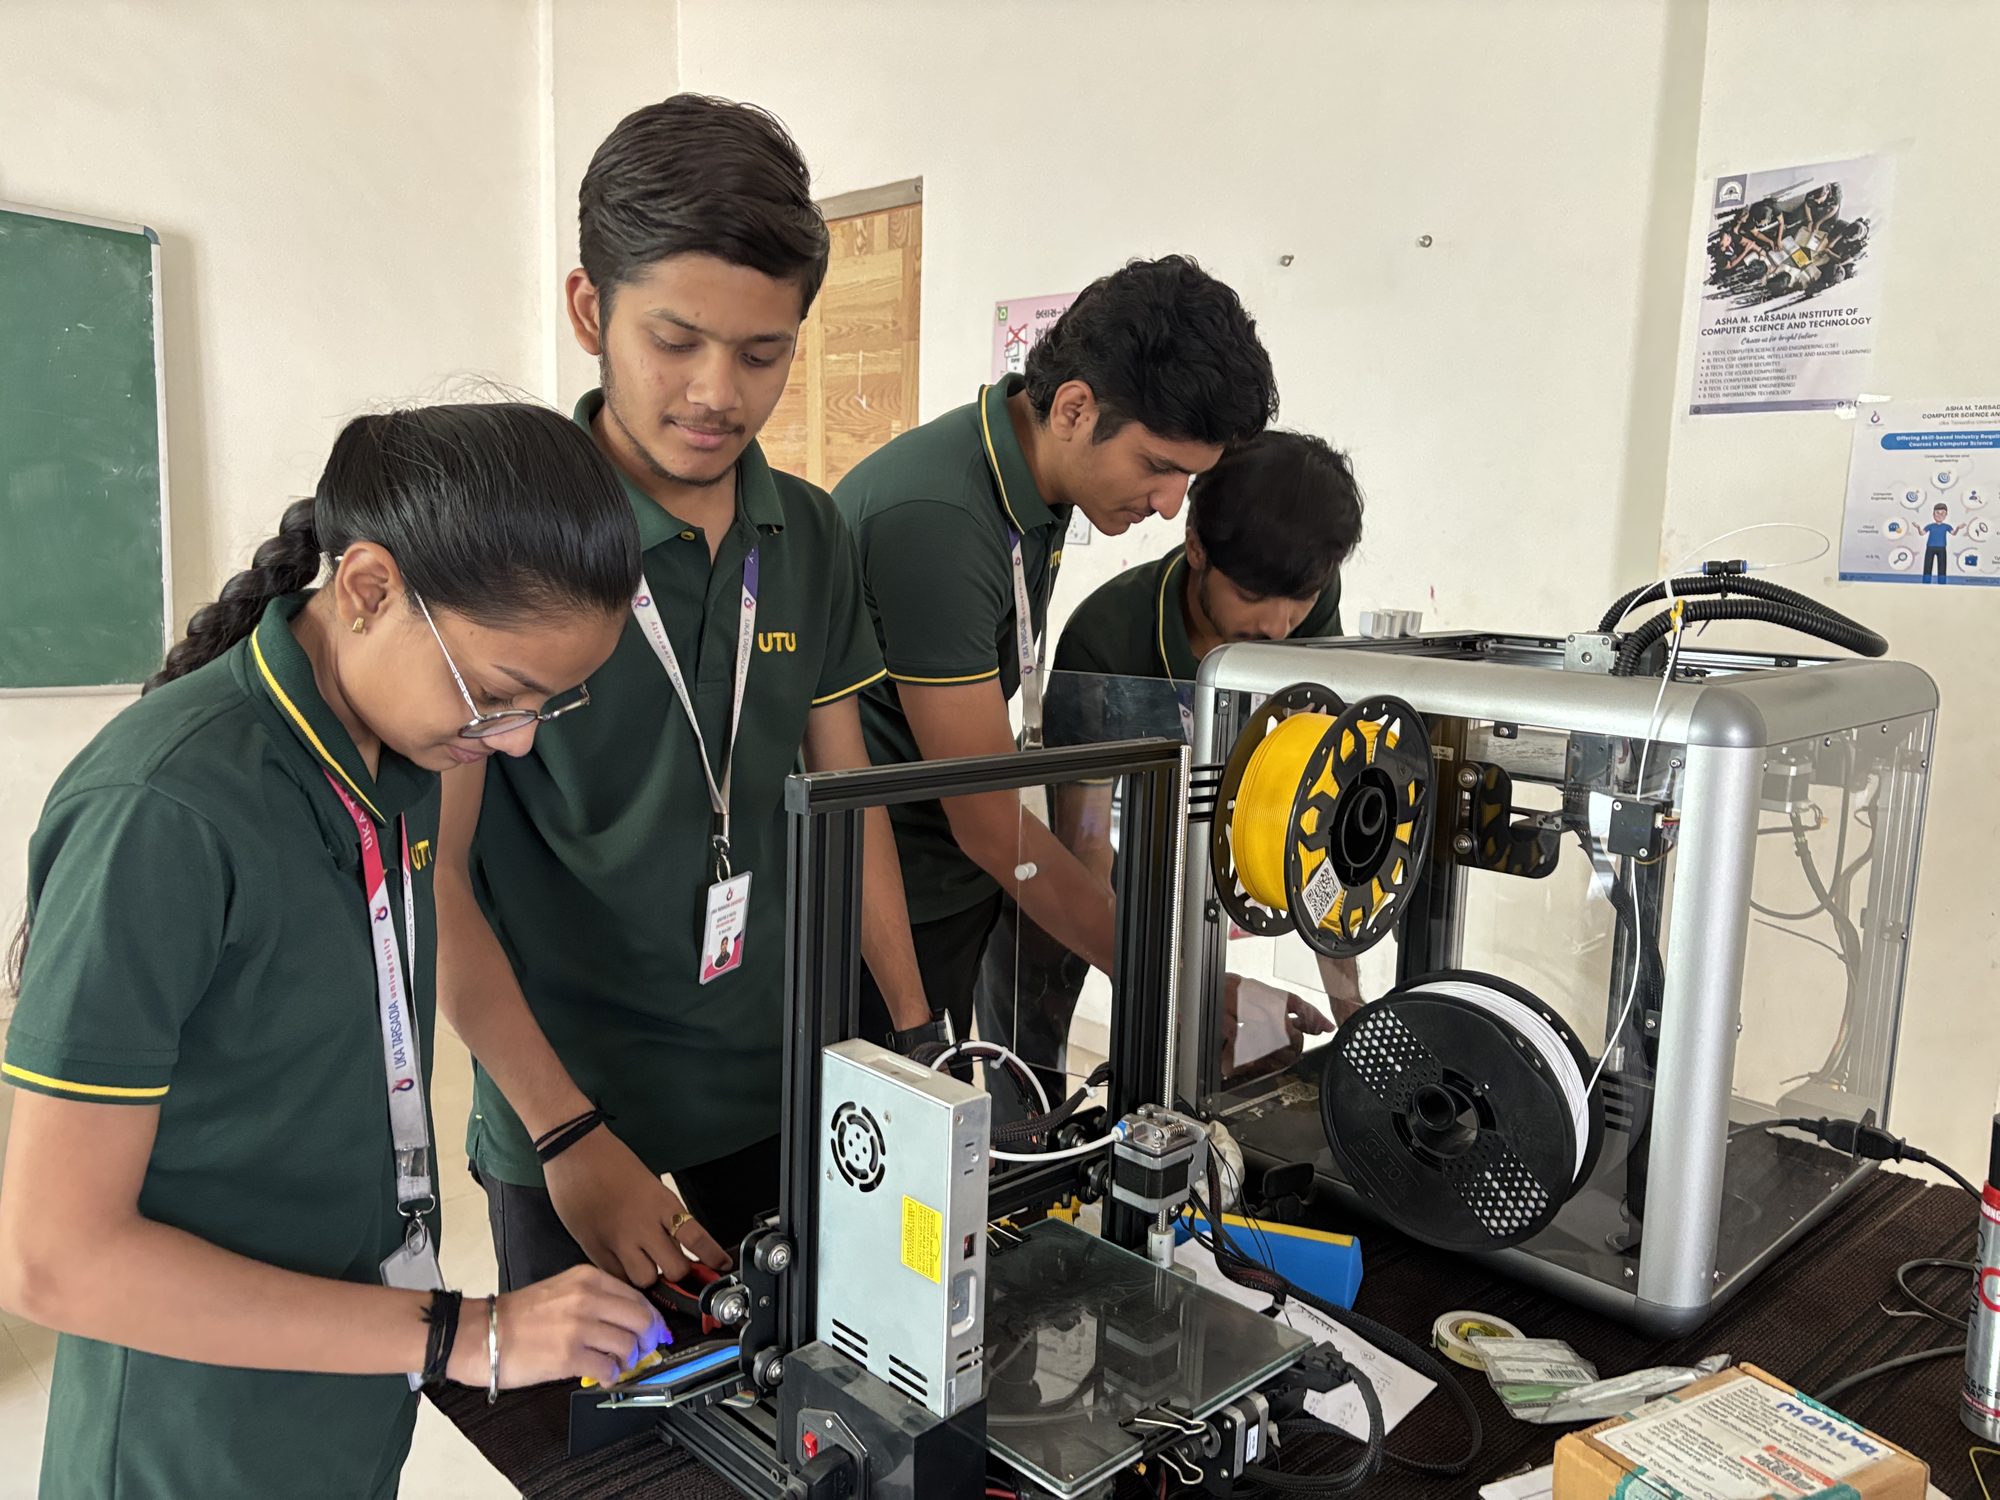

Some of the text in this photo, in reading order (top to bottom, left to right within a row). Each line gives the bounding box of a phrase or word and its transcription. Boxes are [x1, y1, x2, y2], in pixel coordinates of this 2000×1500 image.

[1701, 317, 1872, 336] COMPUTER SCIENCE AND TECHNOLOGY
[1715, 308, 1858, 325] ASHA M. TARSADIA INSTITUTE OF
[758, 632, 797, 653] UTU
[358, 811, 373, 851] UKA
[410, 839, 432, 871] UT
[383, 938, 407, 1070] UKA TARSADIA university
